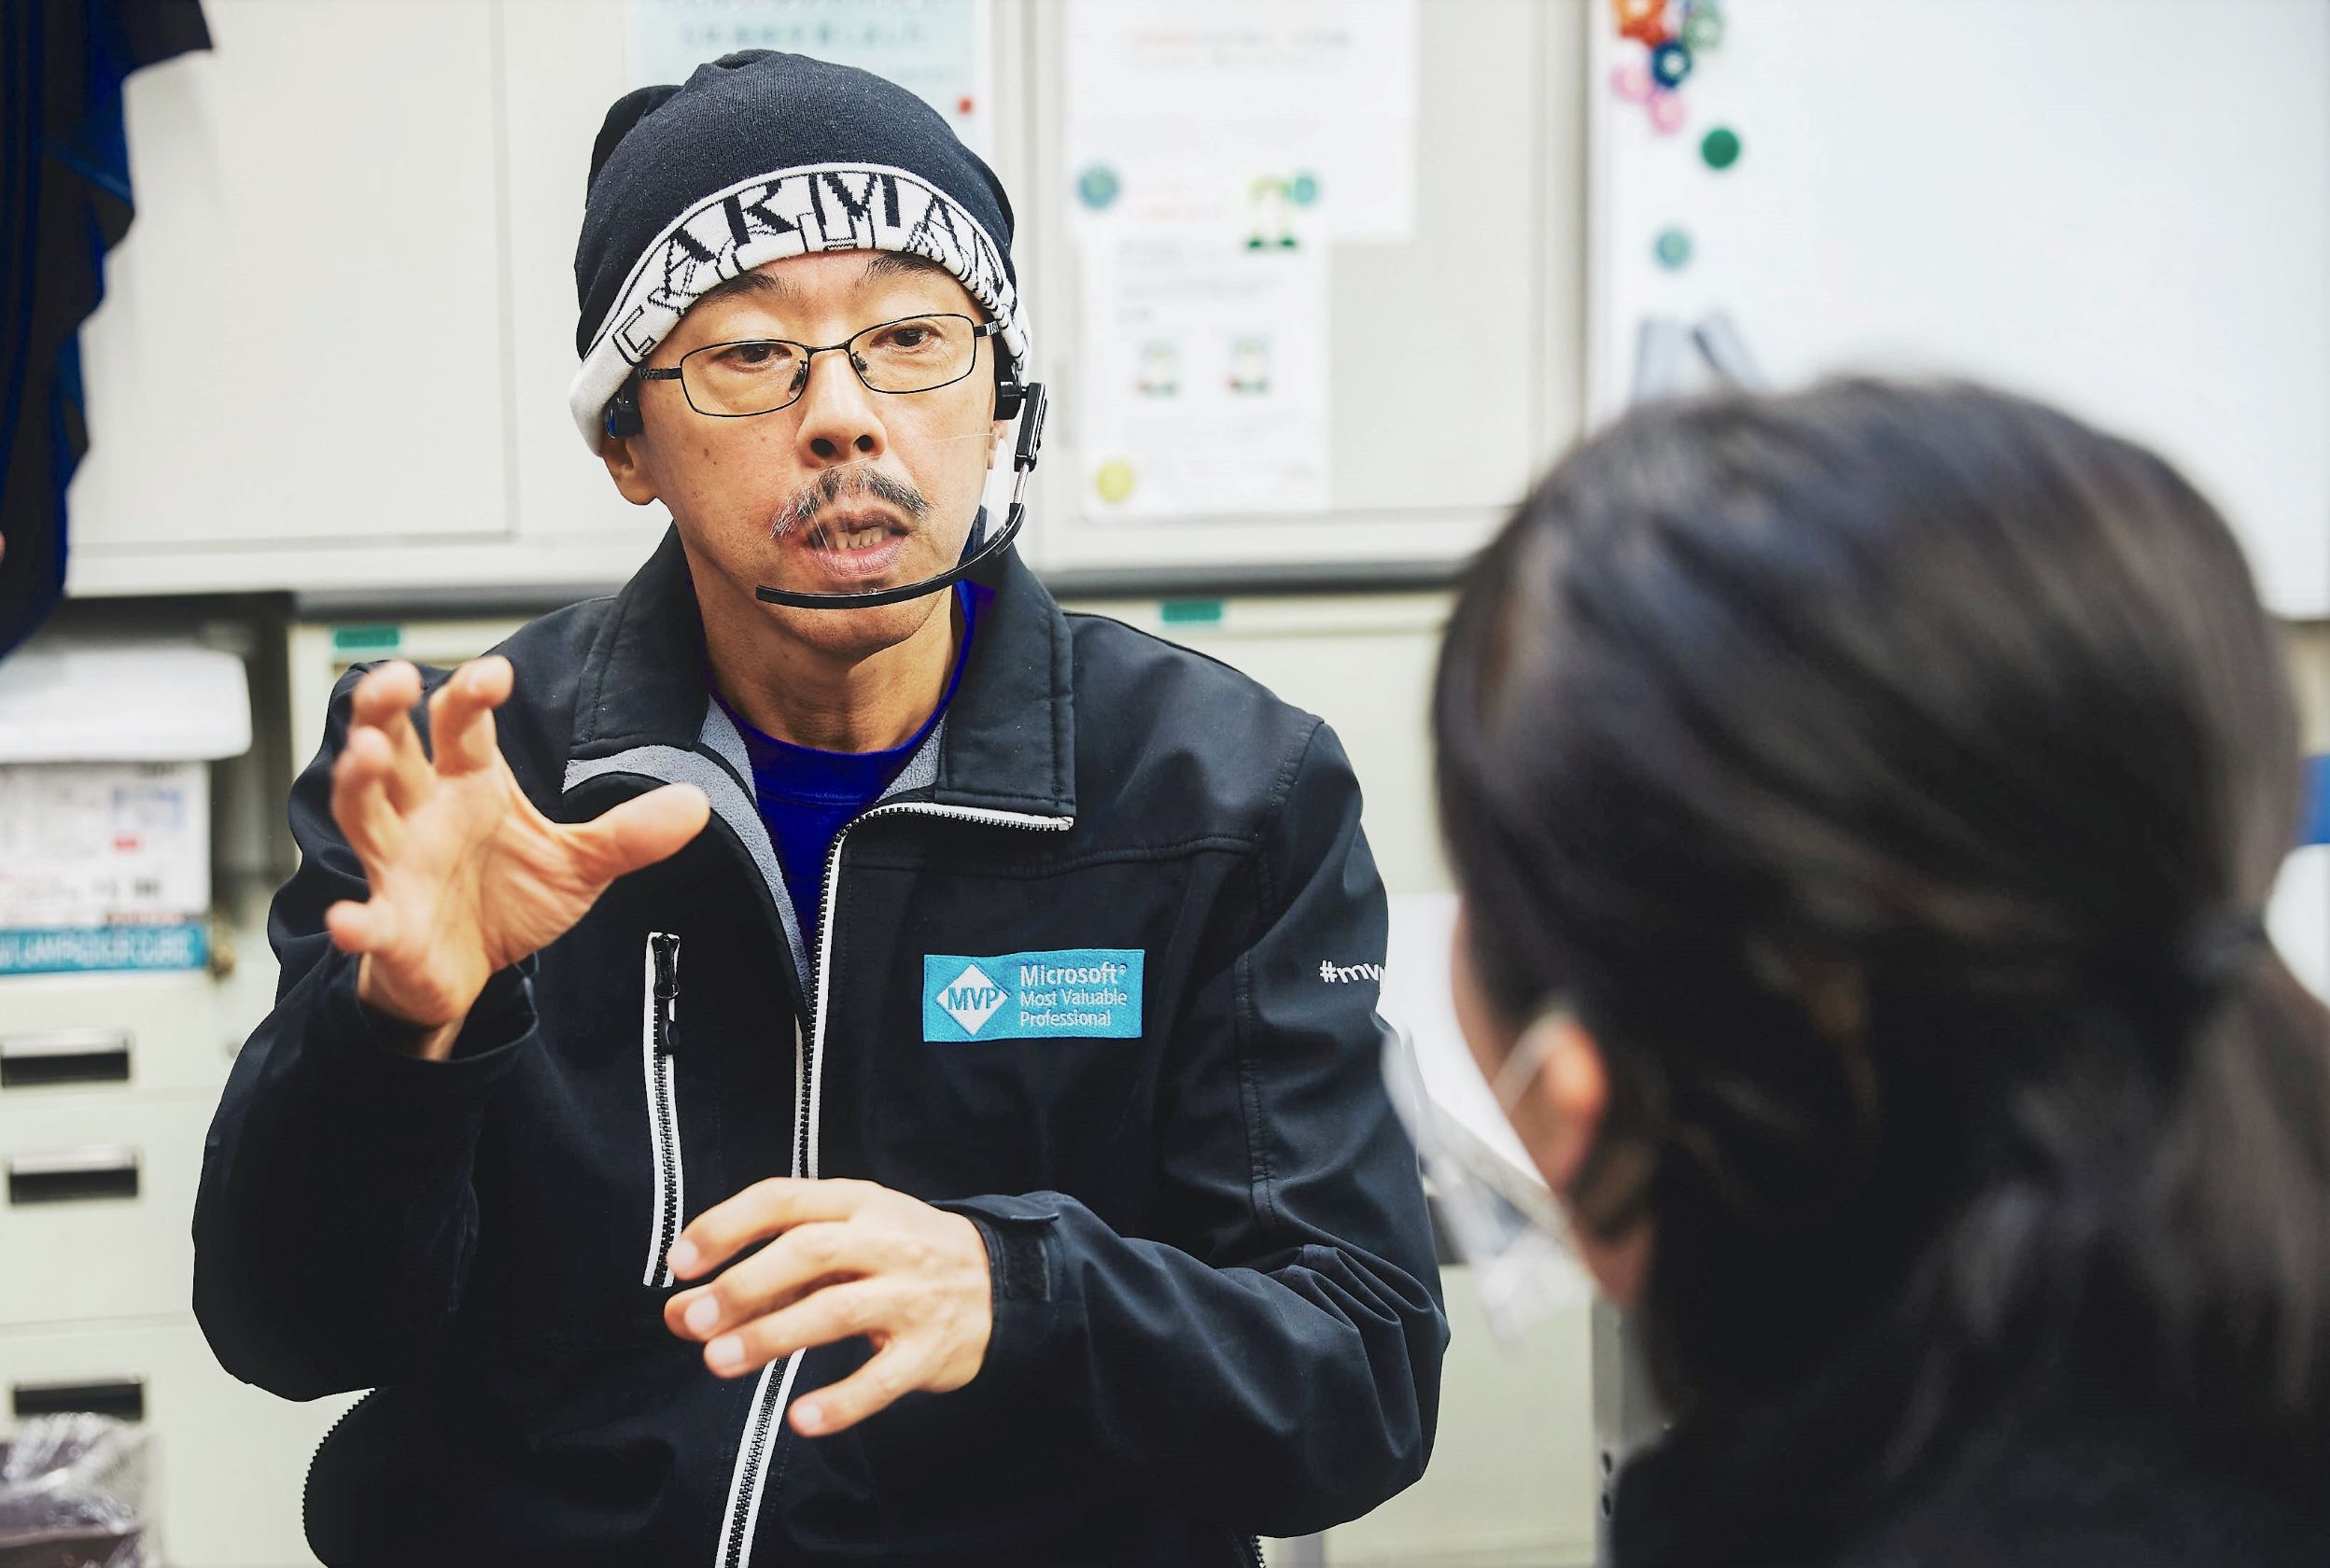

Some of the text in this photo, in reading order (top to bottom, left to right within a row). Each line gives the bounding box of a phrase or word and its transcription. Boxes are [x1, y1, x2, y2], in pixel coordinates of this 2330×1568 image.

[1320, 960, 1385, 984] #mv
[947, 987, 1000, 1011] MVP
[1019, 988, 1127, 1007] Most Valuable
[1019, 1009, 1112, 1028] Professional
